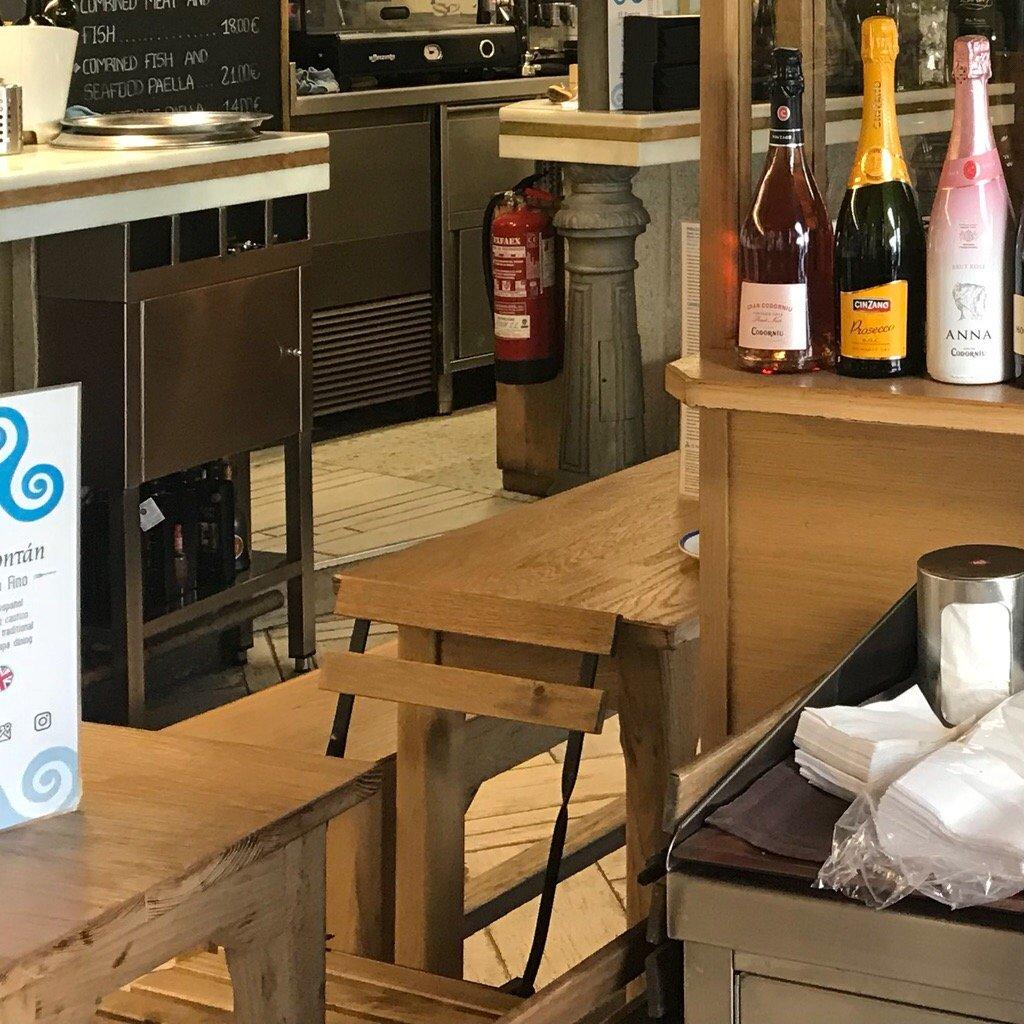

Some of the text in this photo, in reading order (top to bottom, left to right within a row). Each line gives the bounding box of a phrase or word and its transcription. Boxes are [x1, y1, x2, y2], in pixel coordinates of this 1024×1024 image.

[82, 25, 116, 45] FISH
[82, 48, 209, 75] COMBINED FISH AND
[148, 74, 195, 95] PAELLA
[854, 300, 889, 310] CINZANO
[849, 320, 896, 337] Prosecco
[945, 329, 992, 341] ANNA
[0, 542, 45, 568] ntán
